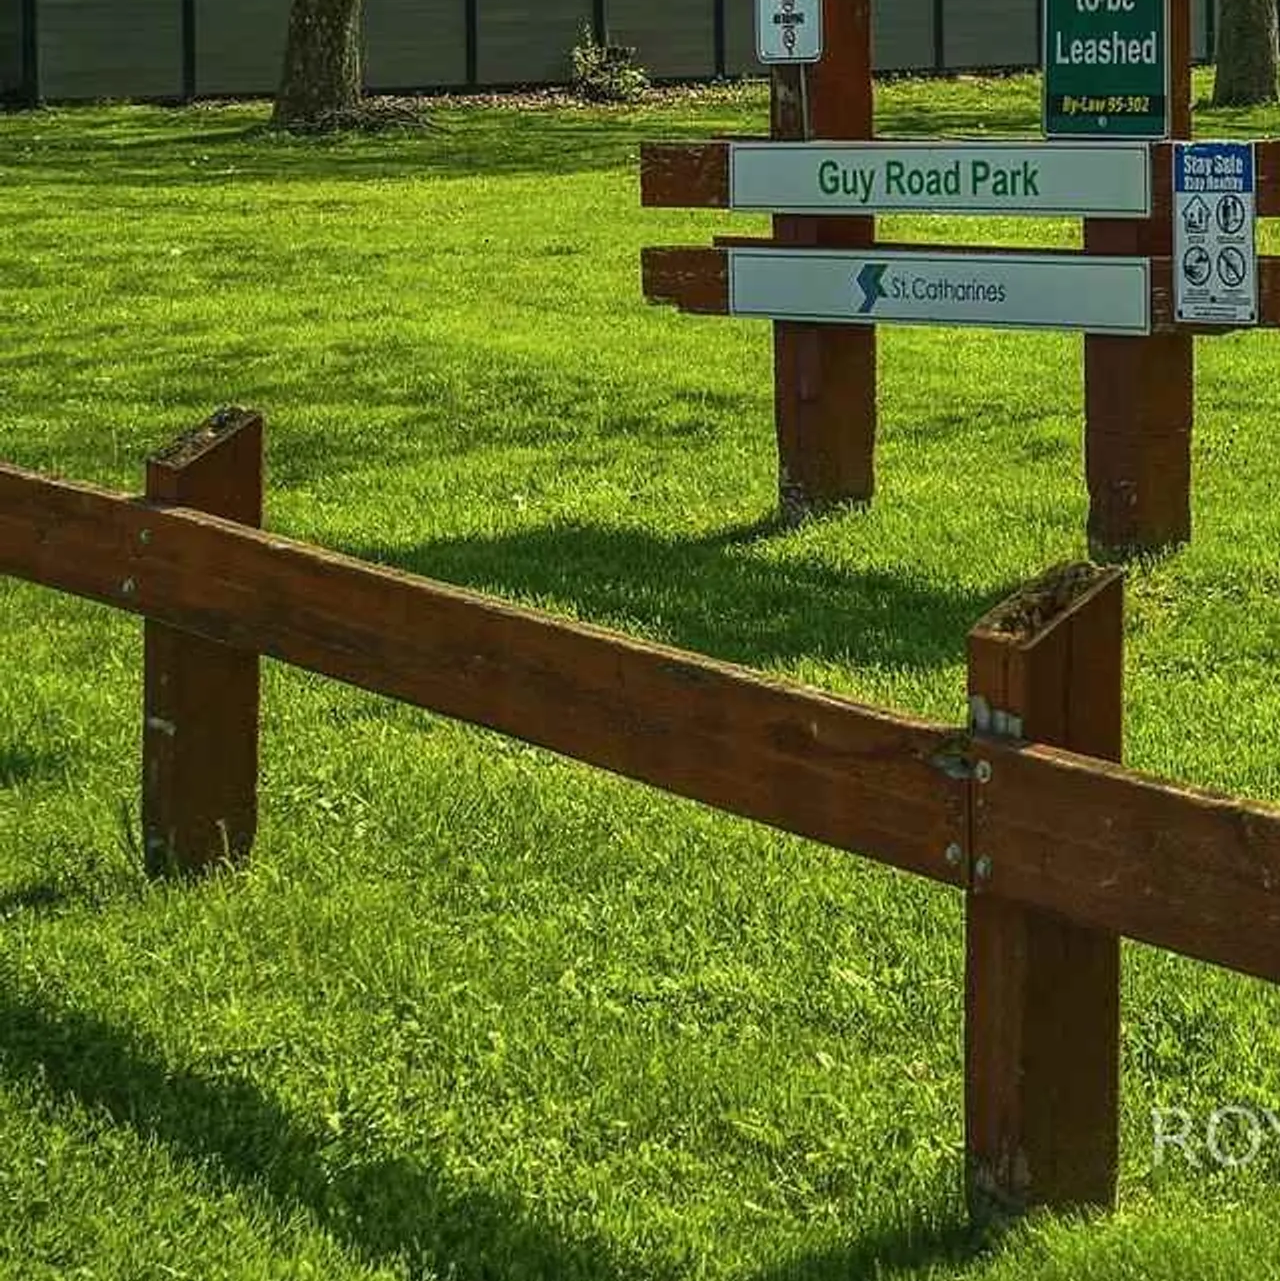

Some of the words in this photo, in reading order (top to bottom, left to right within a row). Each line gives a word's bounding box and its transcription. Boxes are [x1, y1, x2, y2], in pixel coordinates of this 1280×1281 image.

[1055, 30, 1158, 65] Leashed
[818, 159, 874, 204] Guy
[885, 160, 961, 196] Road
[971, 160, 1040, 197] Park
[911, 277, 1006, 303] Catharines
